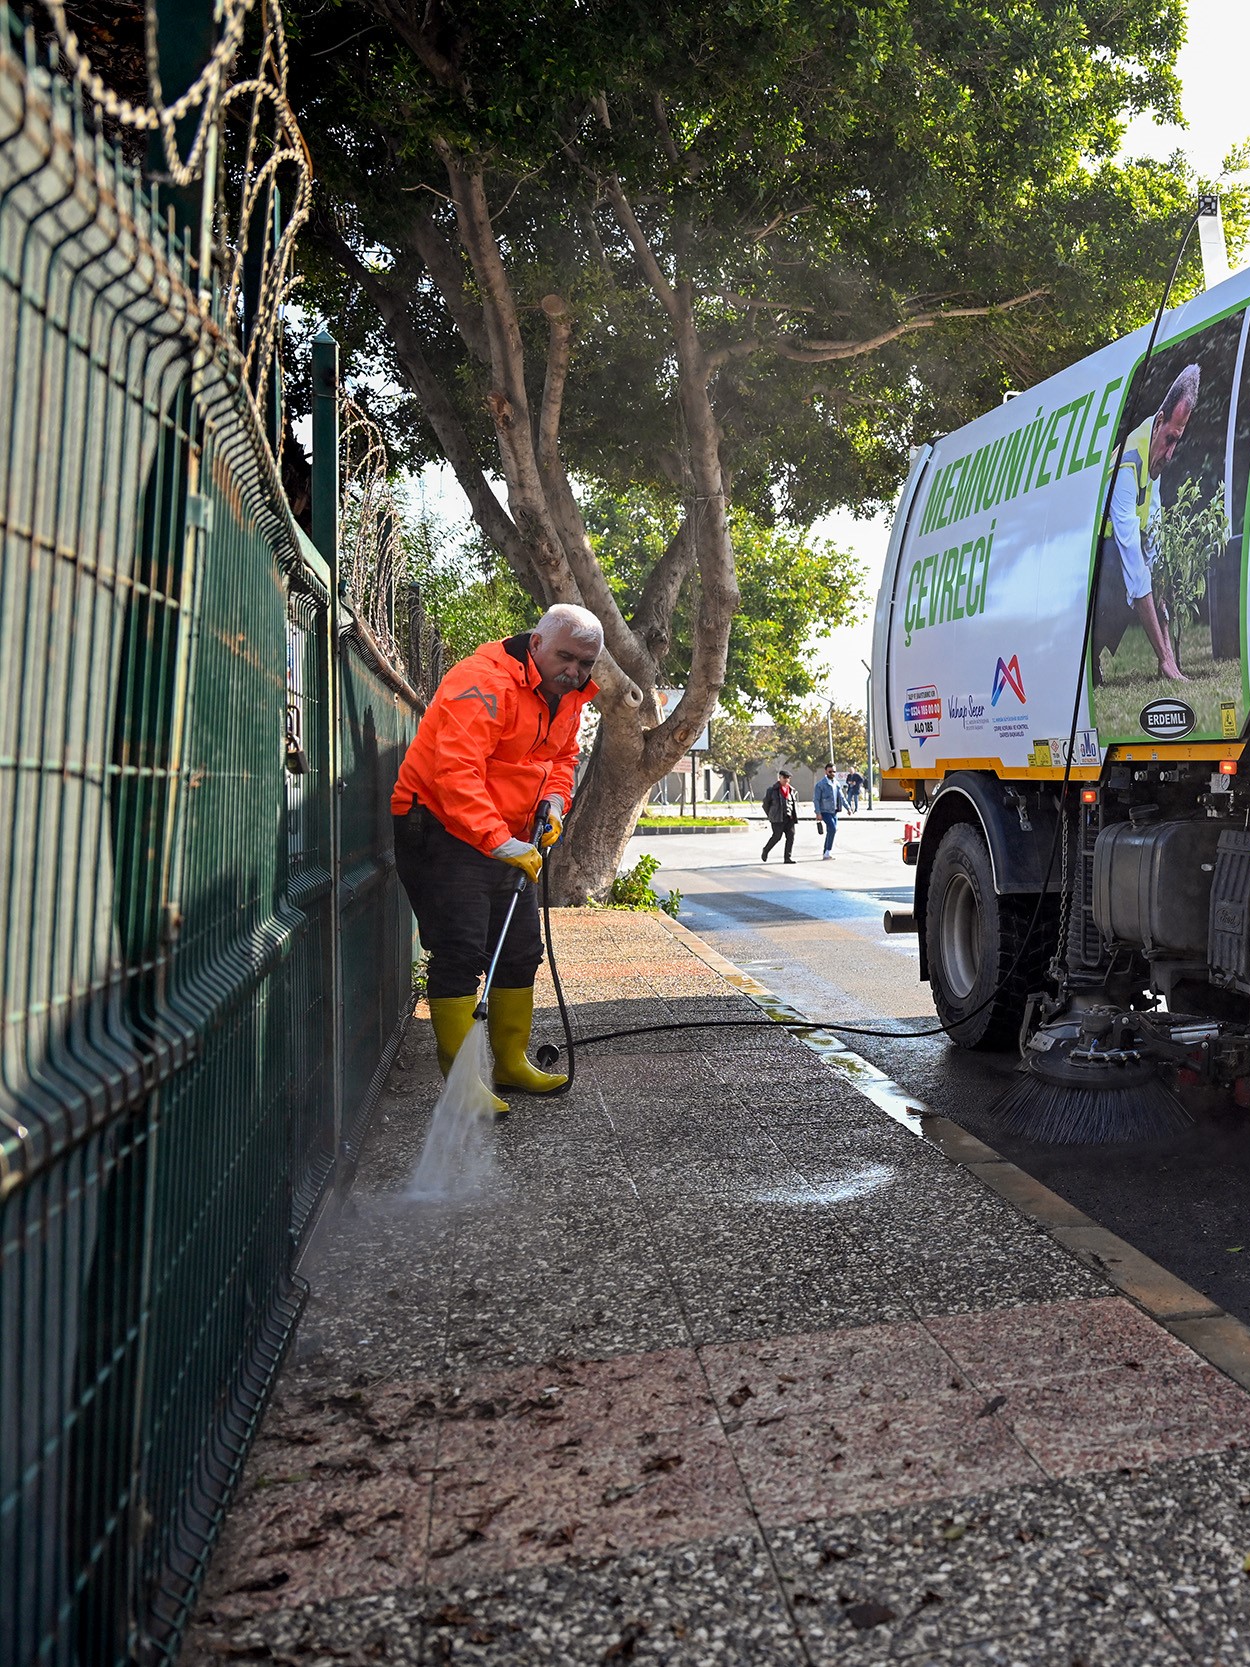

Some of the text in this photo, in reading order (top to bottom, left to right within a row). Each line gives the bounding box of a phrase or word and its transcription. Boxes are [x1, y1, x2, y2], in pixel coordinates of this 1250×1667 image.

[919, 376, 1123, 537] MEMNUNİYETLE
[904, 518, 997, 647] ÇEVRECİ
[914, 722, 924, 734] ALO
